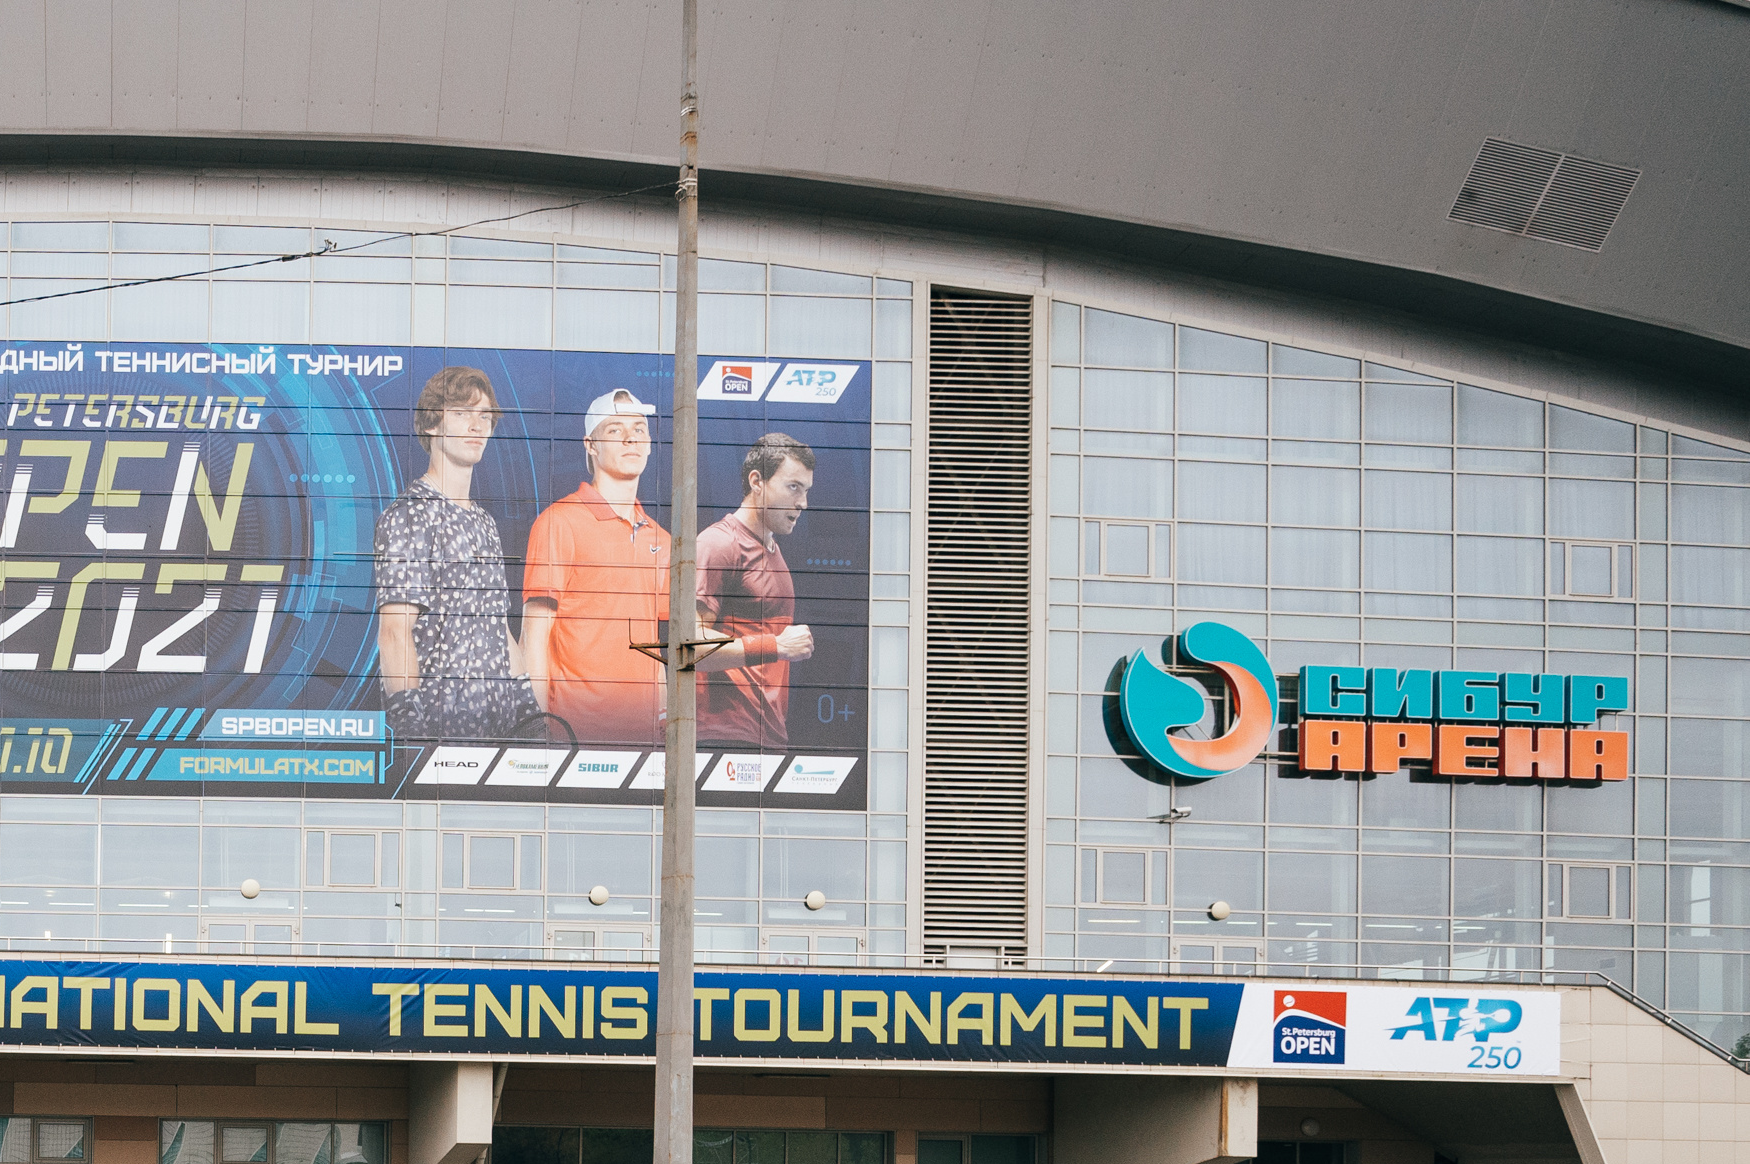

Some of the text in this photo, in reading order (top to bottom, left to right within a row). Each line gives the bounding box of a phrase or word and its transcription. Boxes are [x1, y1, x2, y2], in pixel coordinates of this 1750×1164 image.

[98, 346, 276, 375] ТЕННИСНЫЙ
[288, 353, 403, 377] ТУРНИР
[724, 383, 749, 392] OPEN
[787, 369, 836, 386] ATP
[815, 388, 836, 397] 250
[6, 394, 266, 430] PETERSBURG
[1299, 664, 1628, 724] СИБУР
[817, 694, 856, 723] 0+
[221, 716, 375, 738] SPBOPEN.RU
[1298, 719, 1628, 781] АРЕНА
[179, 756, 374, 777] FORMULATX.COM
[578, 763, 619, 773] SIBUR
[371, 983, 649, 1040] TENNIS
[693, 986, 1209, 1050] TOURNAMENT
[1383, 996, 1523, 1042] ATP
[1280, 1037, 1336, 1056] OPEN
[1466, 1045, 1522, 1069] 250
